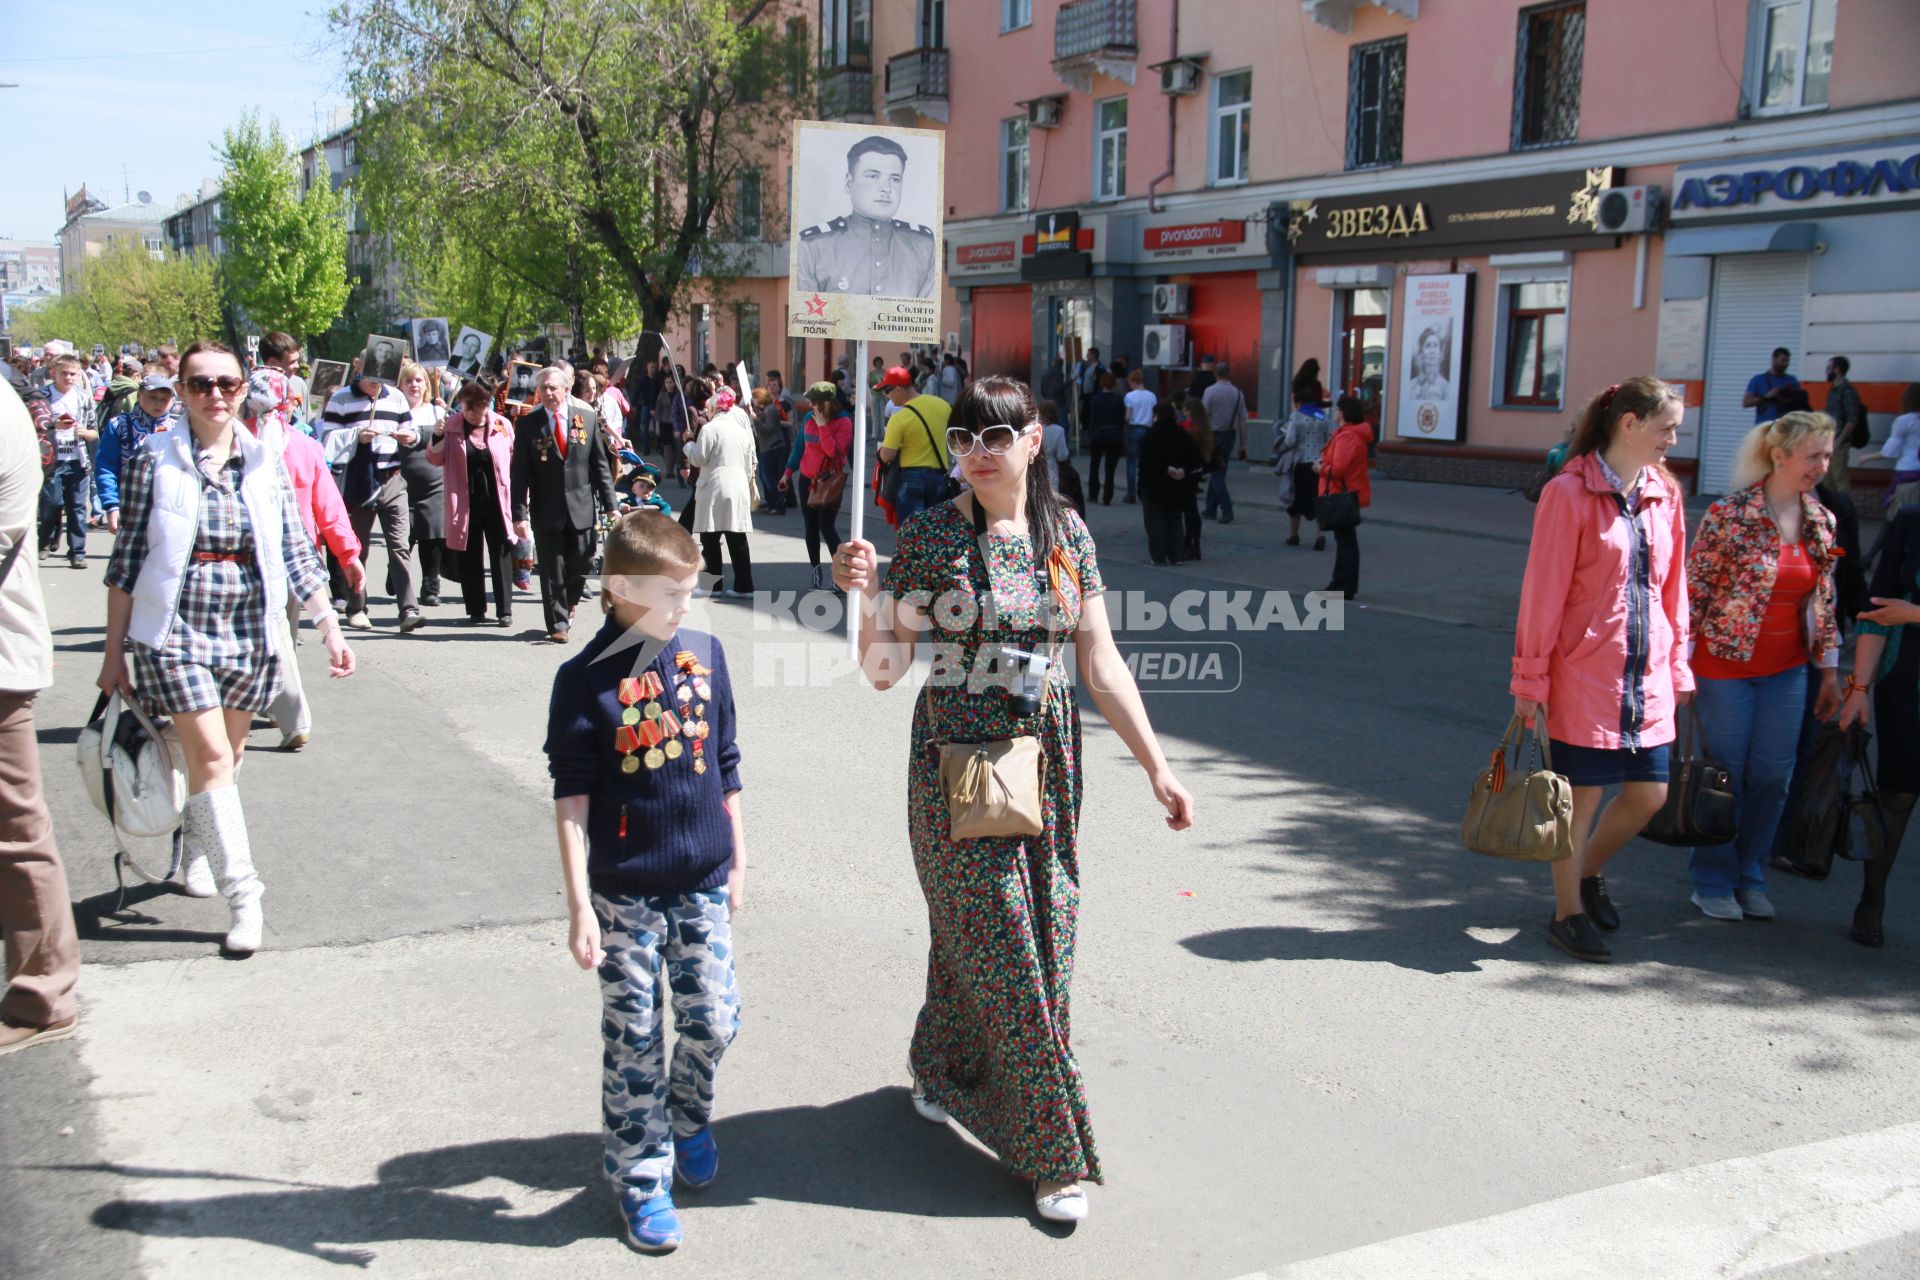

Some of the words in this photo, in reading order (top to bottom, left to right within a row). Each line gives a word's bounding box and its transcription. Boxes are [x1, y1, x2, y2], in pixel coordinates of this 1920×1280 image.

[1325, 201, 1430, 239] ЗВЕЗДА
[1160, 226, 1222, 244] pivonadom.ru
[896, 304, 934, 315] Солято
[878, 312, 934, 324] Станислав
[803, 326, 828, 335] ПОЛК
[868, 321, 934, 334] Людвигович
